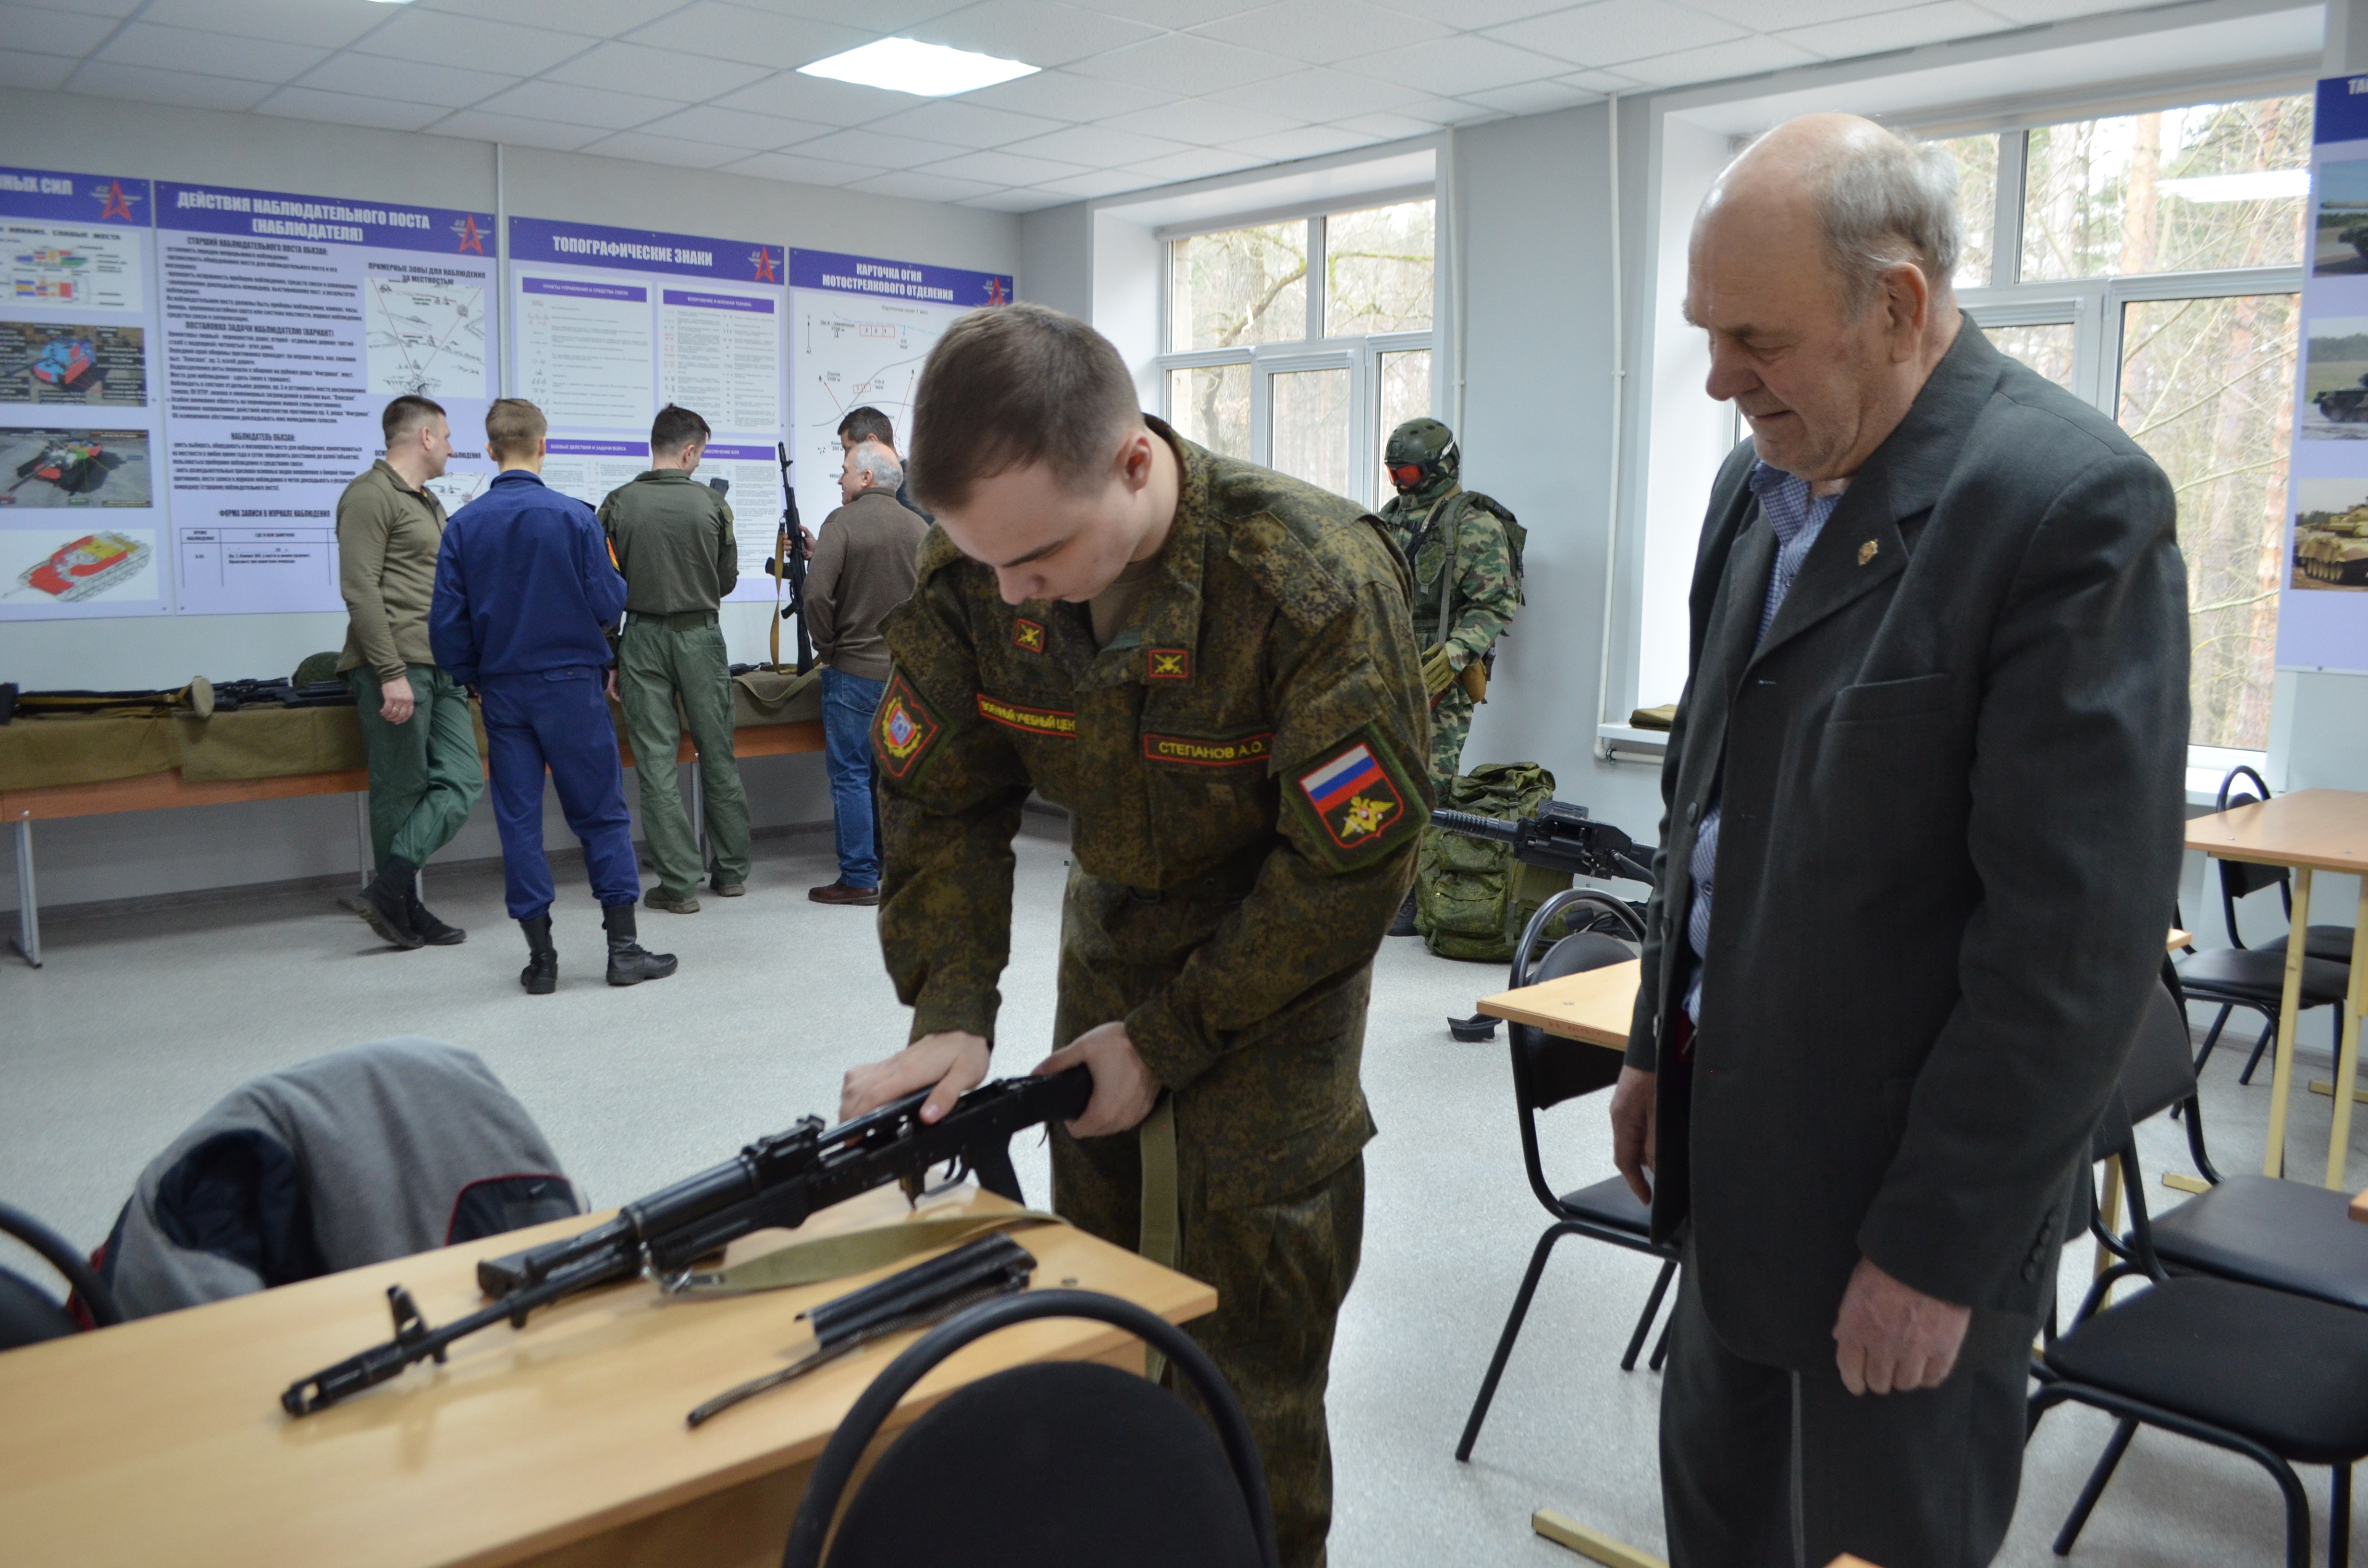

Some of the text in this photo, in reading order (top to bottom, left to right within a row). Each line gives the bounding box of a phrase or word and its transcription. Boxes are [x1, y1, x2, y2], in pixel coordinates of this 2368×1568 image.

[40, 177, 73, 195] СИЛ
[177, 190, 431, 230] ДЕЙСТВИЯ НАБЛЮДАТЕЛЬНОГО ПОСТА
[252, 218, 364, 242] (НАБЛЮДАТЕЛЯ)
[187, 236, 218, 246] СТАРШИЙ
[218, 239, 282, 252] НАБЛЮДАТЕЛЬНОГО
[283, 244, 302, 253] ПОСТА
[553, 236, 713, 267] ТОПОГРАФИЧЕСКИЕ ЗНАКИ
[368, 262, 486, 279] ПРИМЕРНЫЕ ЗОНЫ ДЛЯ НАБЛЮДЕНИЯ
[856, 263, 922, 282] КАРТОЧКА ОГНЯ
[412, 275, 454, 286] МЕСТНОСТЬЮ
[822, 274, 954, 301] МОТОСТРЕЛКОВОГО ОТДЕЛЕНИЯ
[185, 321, 227, 331] ПОСТАНОВКА
[228, 324, 253, 332] ЗАДАЧИ
[254, 326, 302, 335] НАБЛЮДАТЕЛЮ
[231, 432, 272, 441] НАБЛЮДАТЕЛЬ
[1016, 712, 1056, 729] УЧЕБНЫЙ
[1159, 741, 1265, 759] СТЕПАНОВ А.О.
